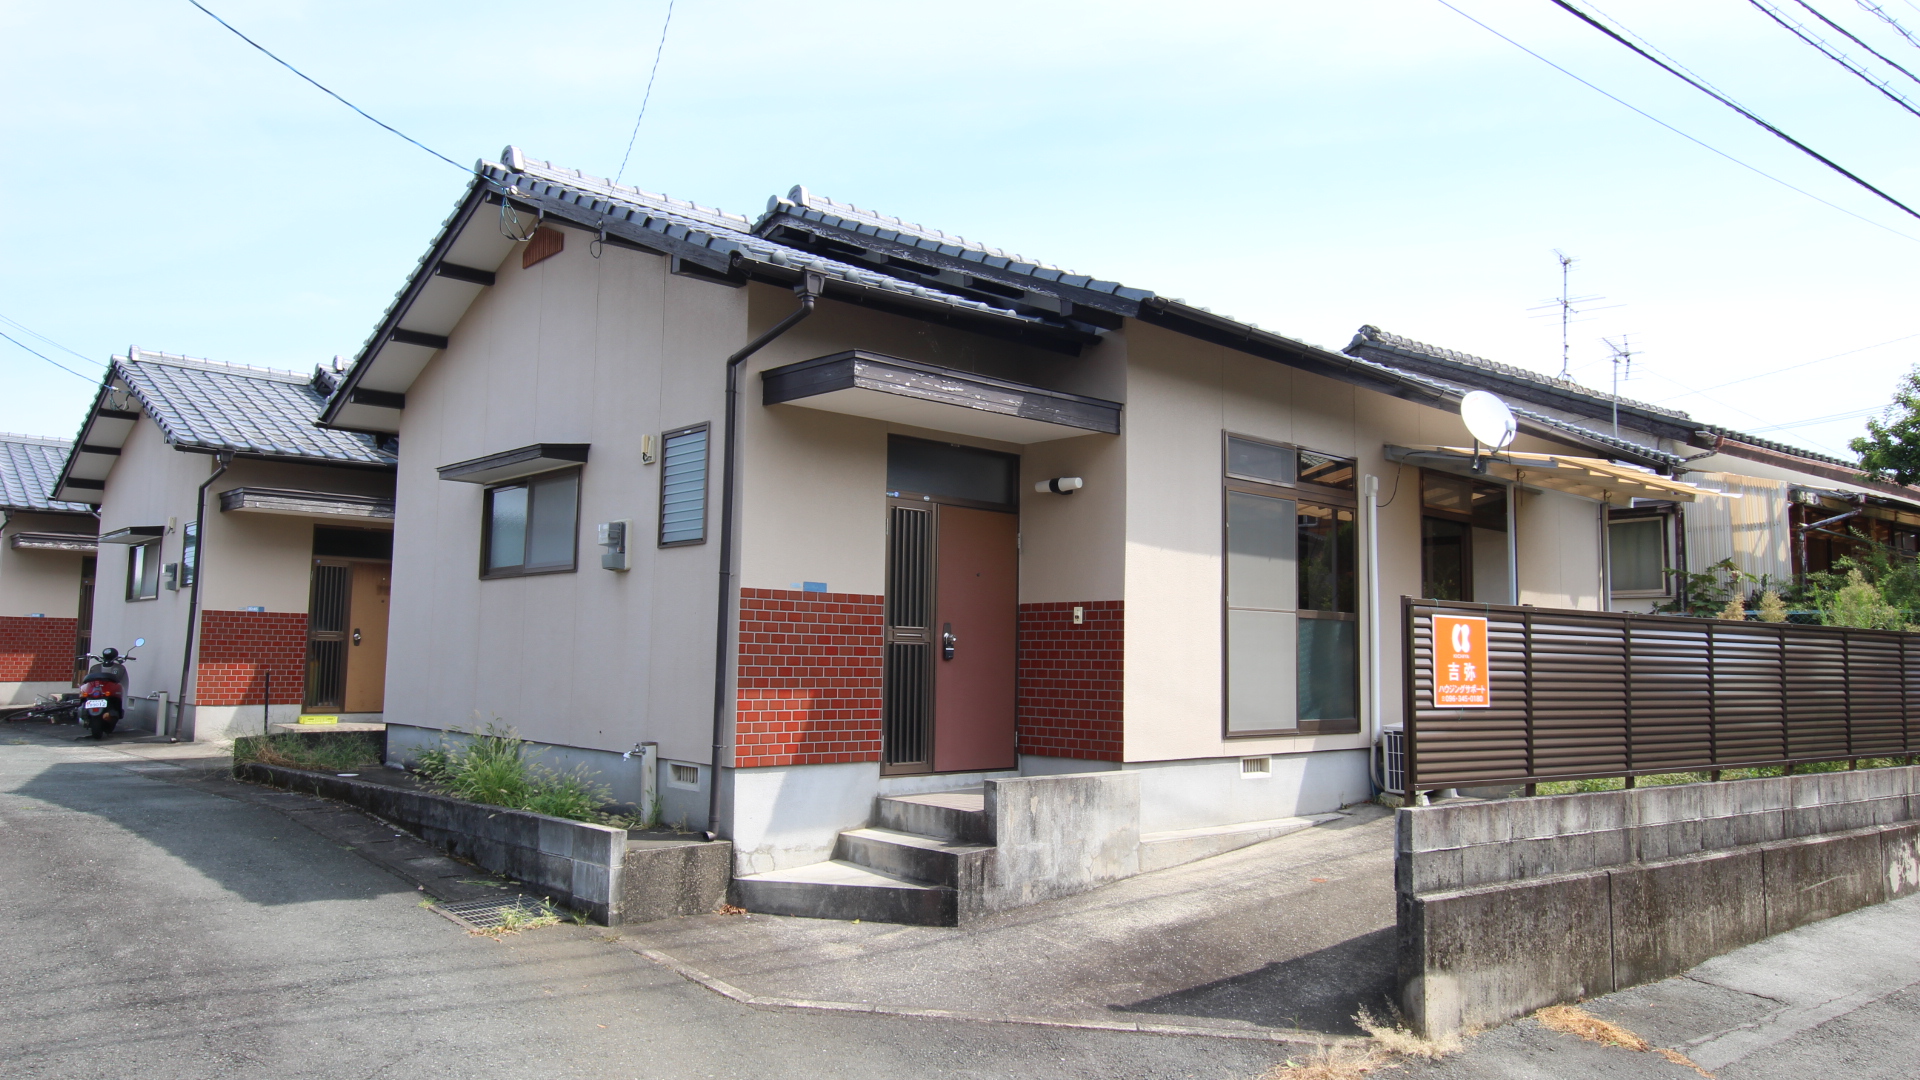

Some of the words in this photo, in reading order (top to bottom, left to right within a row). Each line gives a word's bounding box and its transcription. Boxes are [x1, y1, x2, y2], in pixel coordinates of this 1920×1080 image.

[1438, 684, 1486, 694] ハウジングサポート
